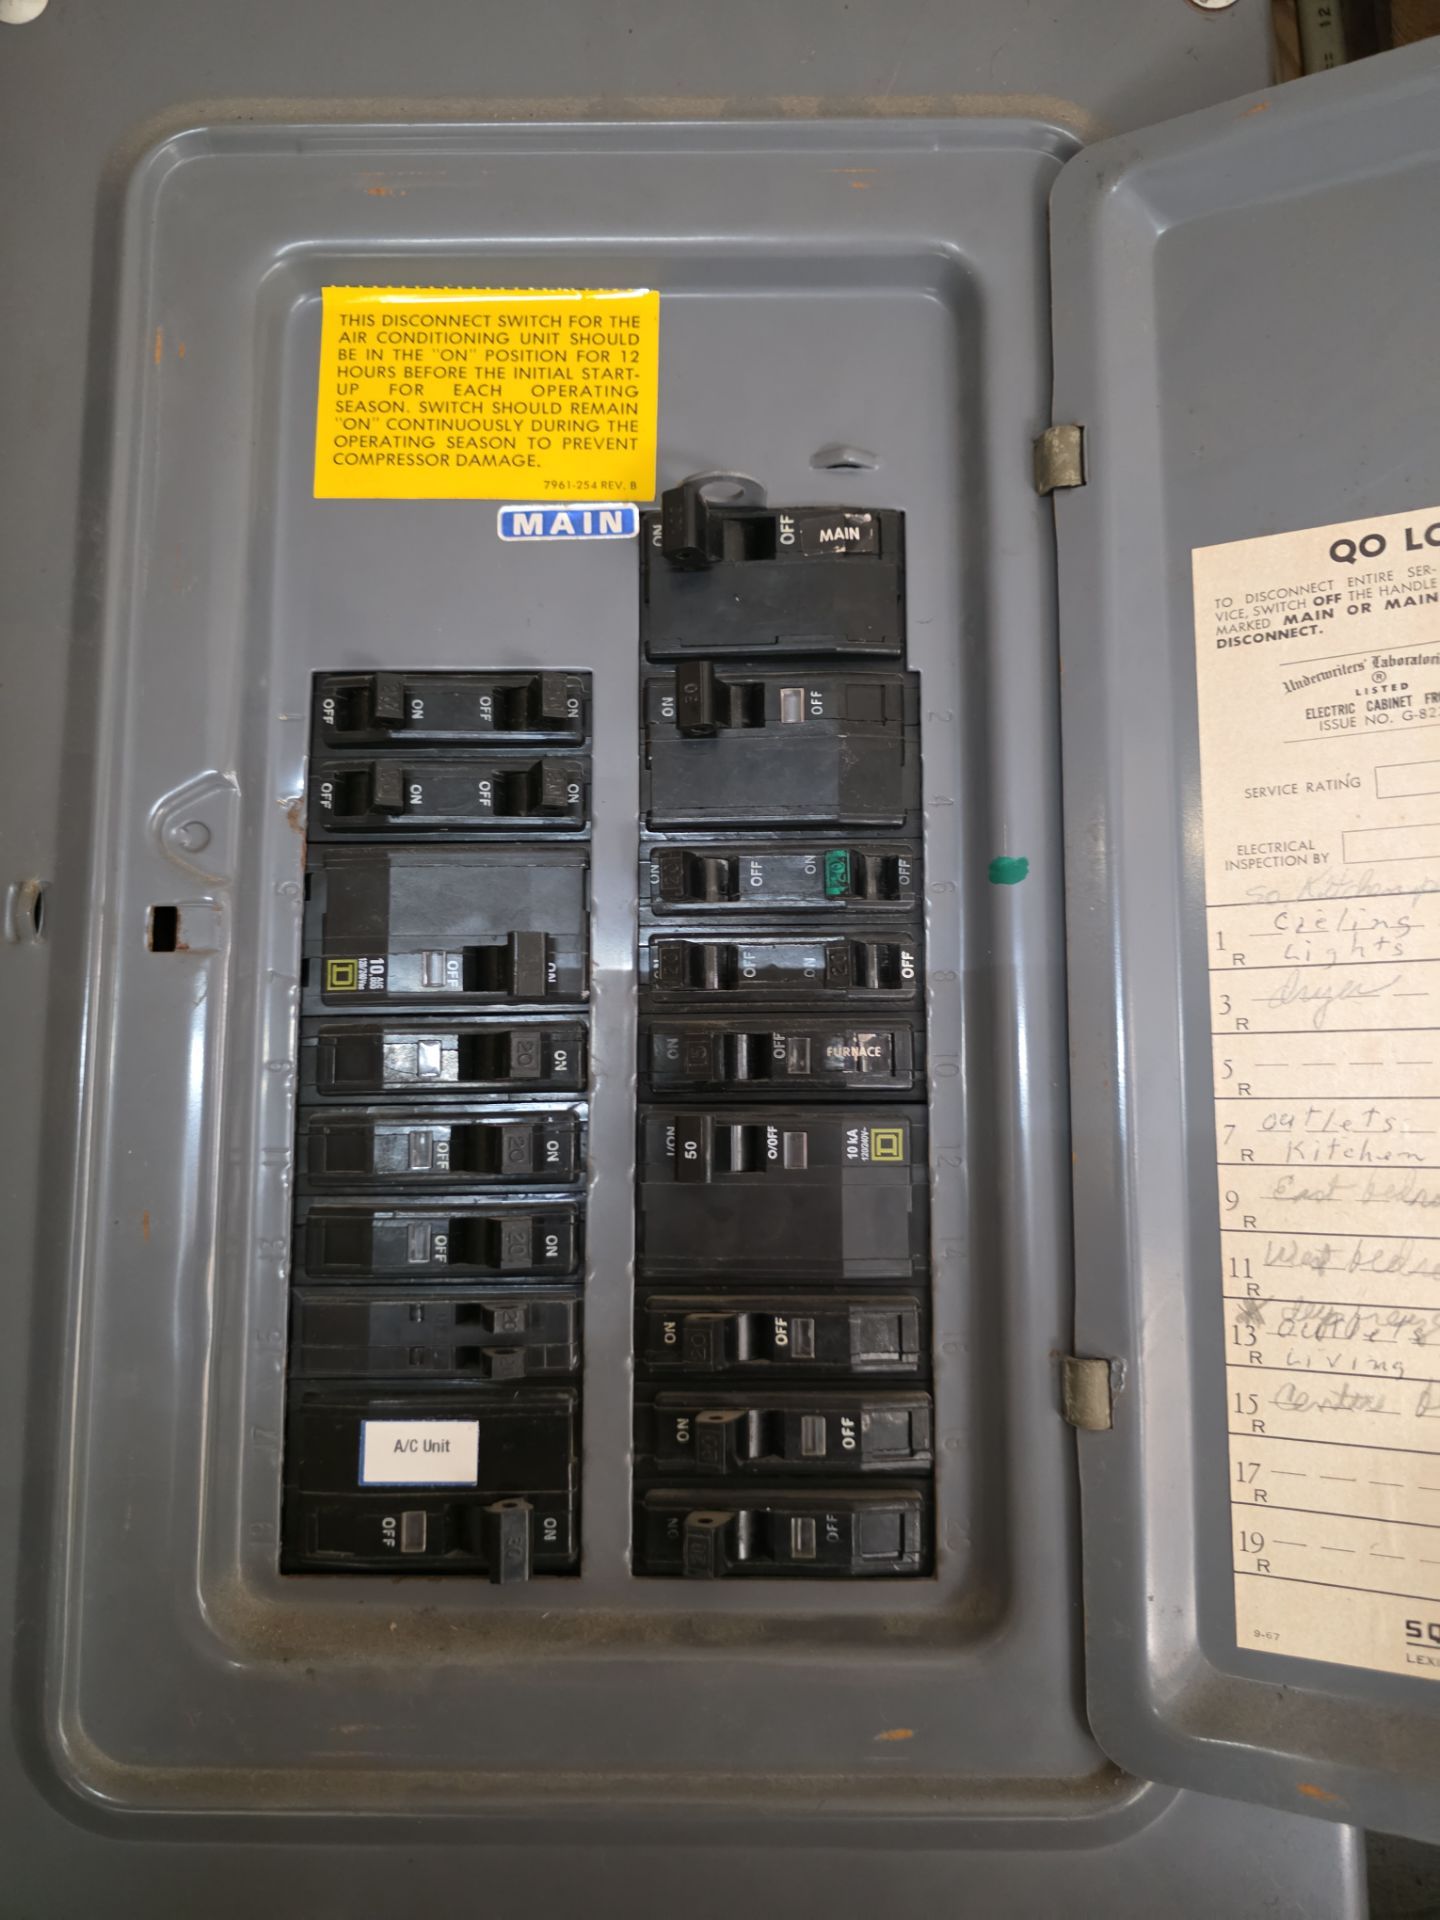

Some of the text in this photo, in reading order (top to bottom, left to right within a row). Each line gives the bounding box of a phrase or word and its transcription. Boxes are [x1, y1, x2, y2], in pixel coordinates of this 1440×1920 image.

[339, 314, 640, 328] THIS DISCONNECT SWITCH FOR THE
[339, 332, 640, 346] AIR CONDITIONING UNIT SHOULD
[338, 349, 639, 363] BE IN THE "ON" POSITION FOR 12
[337, 366, 640, 380] HOURS BEFORE THE INITIAL START-
[336, 383, 639, 398] UP FOR EACH OPERATING
[335, 401, 638, 415] SEASON. SWITCH SHOULD REMAIN
[335, 417, 638, 432] "ON" CONTINUOUSLY DURING THE
[334, 435, 638, 450] OPERATING SEASON TO PREVENT
[333, 453, 540, 467] COMPRESSOR DAMAGE.
[544, 480, 637, 490] 7961-254 REV. B
[513, 512, 623, 536] MAIN
[780, 514, 795, 545] OFF
[819, 527, 860, 543] MAIN
[1329, 533, 1386, 564] QO
[1215, 565, 1437, 609] TO DISCONNECT ENTIRE SER-
[1216, 578, 1437, 622] VICE, SWITCH OFF THE HANDLE
[1216, 593, 1439, 635] MARKED MAIN OR MAIN
[1216, 625, 1323, 649] DISCONNECT.
[1356, 682, 1409, 696] LISTED
[323, 699, 335, 726] OFF
[411, 699, 424, 719] ON
[480, 696, 492, 722] OFF
[567, 699, 579, 718] ON
[662, 697, 674, 717] ON
[811, 691, 823, 715] OFF
[1305, 702, 1355, 719] ELECTRIC
[1366, 696, 1412, 712] CABINET
[1319, 717, 1357, 732] ISSUE
[1365, 712, 1393, 725] NO.
[320, 782, 333, 809] OFF
[410, 784, 423, 805] ON
[479, 781, 491, 807] OFF
[567, 784, 580, 803] ON
[1244, 776, 1361, 799] SERVICE RATING
[1237, 840, 1315, 856] ELECTRICAL
[805, 856, 817, 875] ON
[899, 858, 911, 885] OFF
[1225, 853, 1330, 871] INSPECTION BY
[651, 864, 660, 885] ON
[751, 861, 763, 887] OFF
[1216, 931, 1225, 951] 1
[743, 952, 756, 978] OFF
[804, 957, 816, 978] ON
[901, 950, 914, 979] OFF
[1232, 953, 1245, 965] R
[447, 960, 459, 988] OFF
[1219, 995, 1231, 1015] 3
[1236, 1018, 1249, 1030] R
[517, 1040, 534, 1066] 20
[666, 1038, 679, 1059] ON
[773, 1032, 786, 1059] OFF
[826, 1046, 881, 1057] FURNACE
[554, 1050, 567, 1072] ON
[1221, 1059, 1233, 1079] 5
[1238, 1083, 1252, 1095] R
[846, 1128, 858, 1159] 10 kA
[1223, 1124, 1235, 1144] 7
[437, 1142, 449, 1170] OFF
[509, 1136, 527, 1163] 20
[546, 1140, 559, 1162] ON
[685, 1141, 697, 1160] 50
[1241, 1149, 1254, 1161] R
[1226, 1190, 1239, 1211] 9
[1244, 1216, 1256, 1228] R
[434, 1235, 448, 1263] OFF
[545, 1234, 558, 1257] ON
[1230, 1257, 1252, 1279] 11
[1247, 1284, 1260, 1296] R
[664, 1321, 676, 1344] ON
[775, 1317, 789, 1346] OFF
[1232, 1325, 1257, 1346] 13
[1249, 1351, 1262, 1364] R
[1235, 1393, 1259, 1415] 15
[677, 1418, 689, 1443] ON
[841, 1417, 856, 1450] OFF
[1252, 1420, 1265, 1433] R
[394, 1439, 450, 1454] A/C Unit
[1236, 1461, 1261, 1483] 17
[1254, 1489, 1267, 1502] R
[382, 1517, 396, 1548] OFF
[544, 1517, 557, 1541] ON
[667, 1518, 678, 1539] ON
[826, 1514, 839, 1543] OFF
[1238, 1531, 1264, 1553] 19
[1257, 1559, 1270, 1572] R
[1253, 1630, 1280, 1642] 9-67
